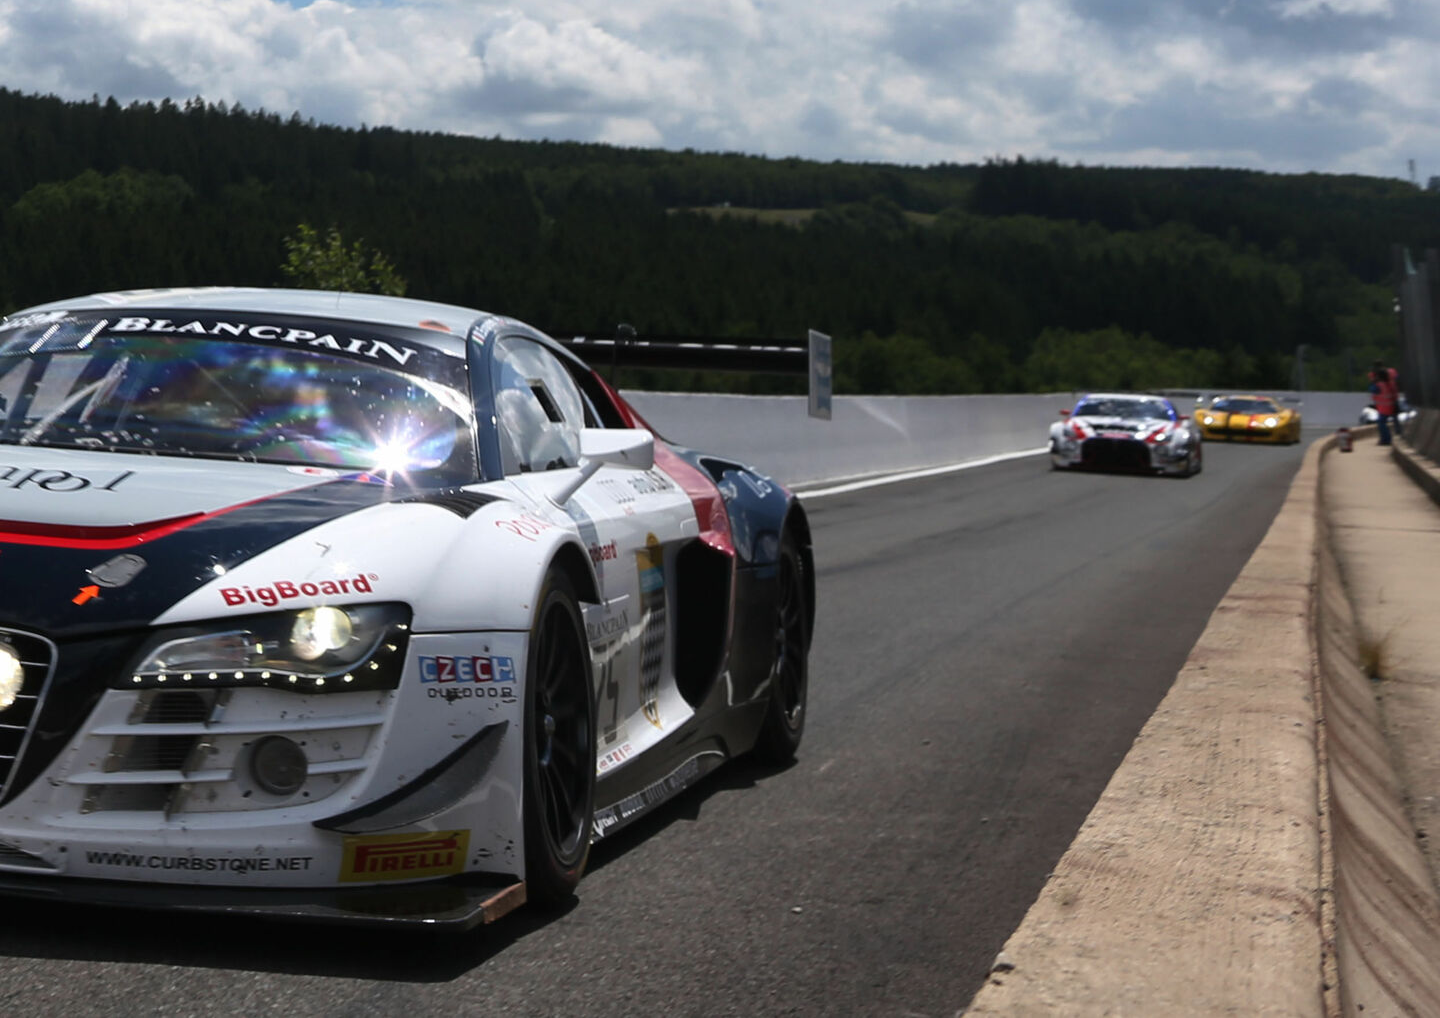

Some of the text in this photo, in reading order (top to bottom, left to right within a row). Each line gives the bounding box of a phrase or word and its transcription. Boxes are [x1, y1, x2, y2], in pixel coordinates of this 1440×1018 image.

[107, 316, 418, 366] BLANCPAIN
[421, 657, 515, 681] CZECH
[86, 850, 313, 873] WWW.CURBSTONE.NET
[353, 839, 458, 874] PIRELLI
